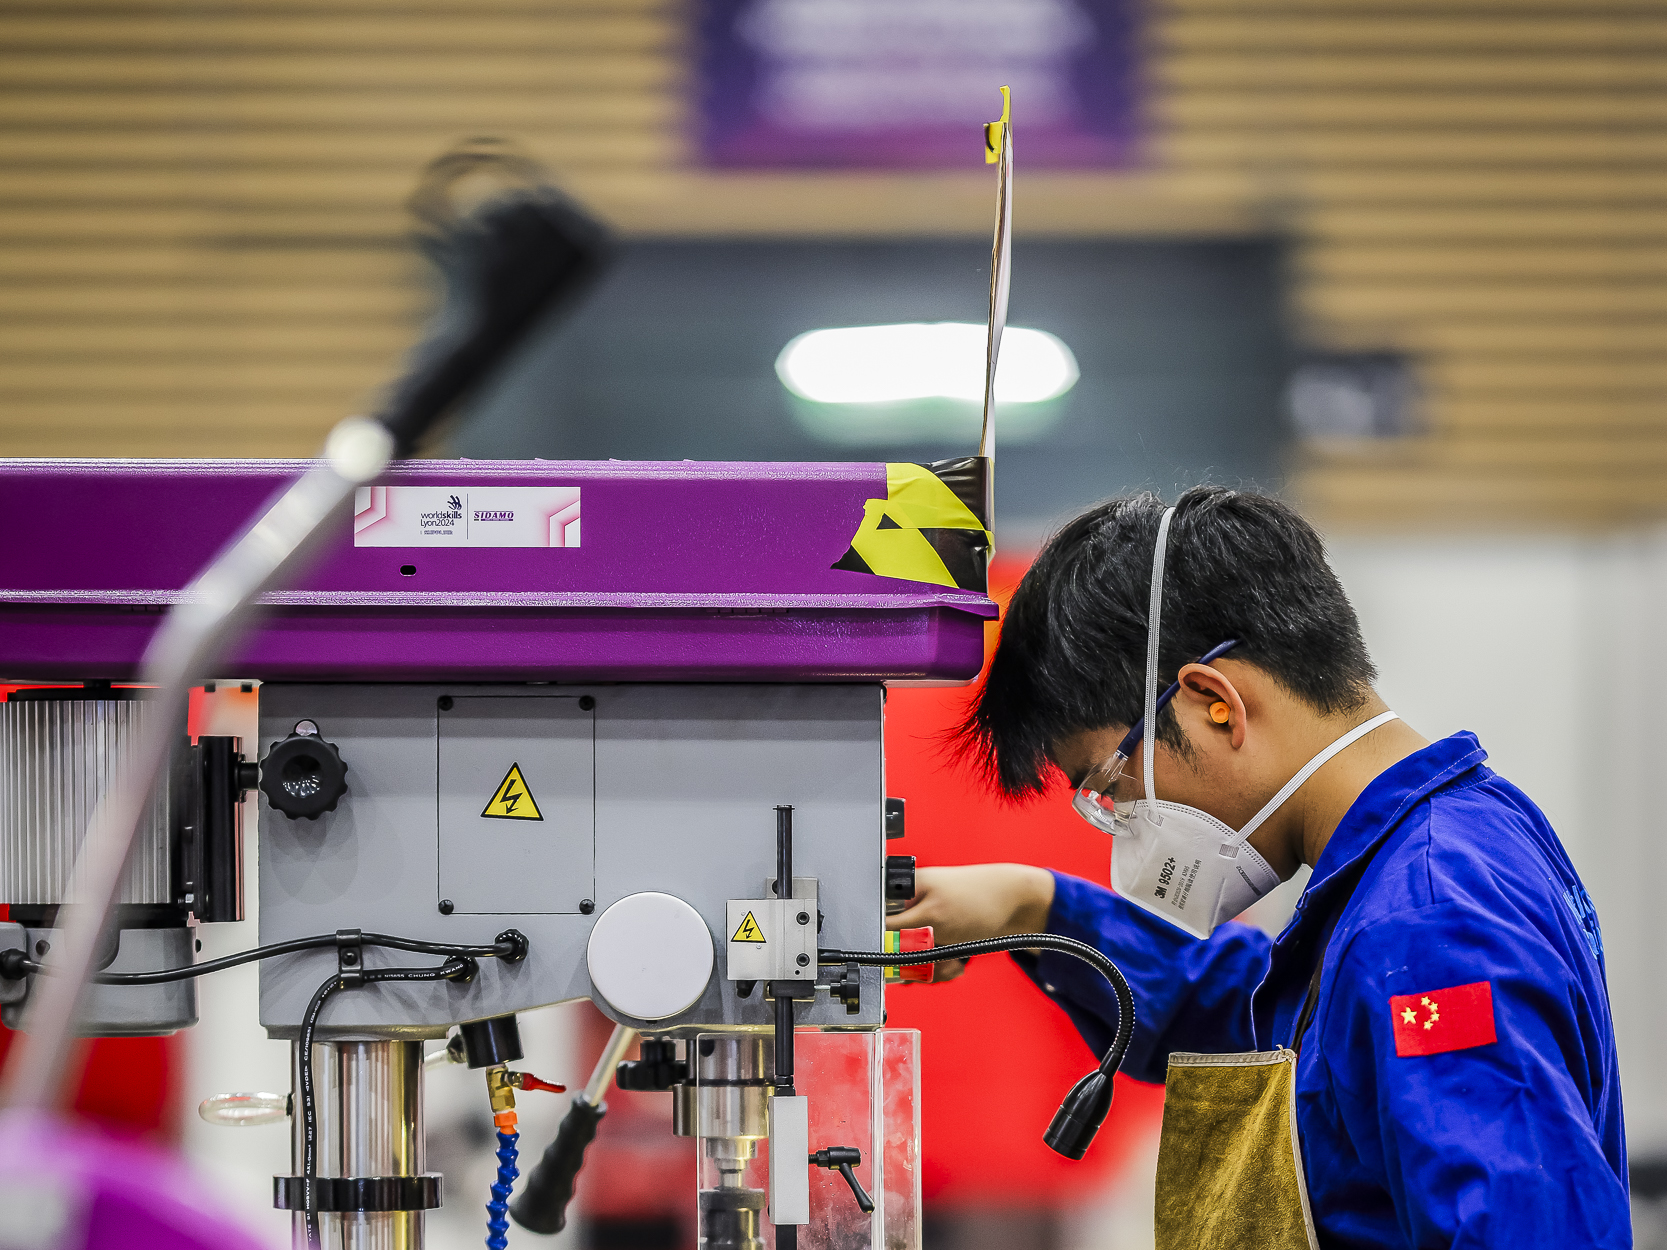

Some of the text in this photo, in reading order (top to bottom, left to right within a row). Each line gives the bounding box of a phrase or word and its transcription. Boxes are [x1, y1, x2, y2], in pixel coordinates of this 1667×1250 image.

[421, 511, 462, 519] worldskills
[474, 511, 514, 519] SIDAMO
[1154, 857, 1176, 899] 3M 9502+
